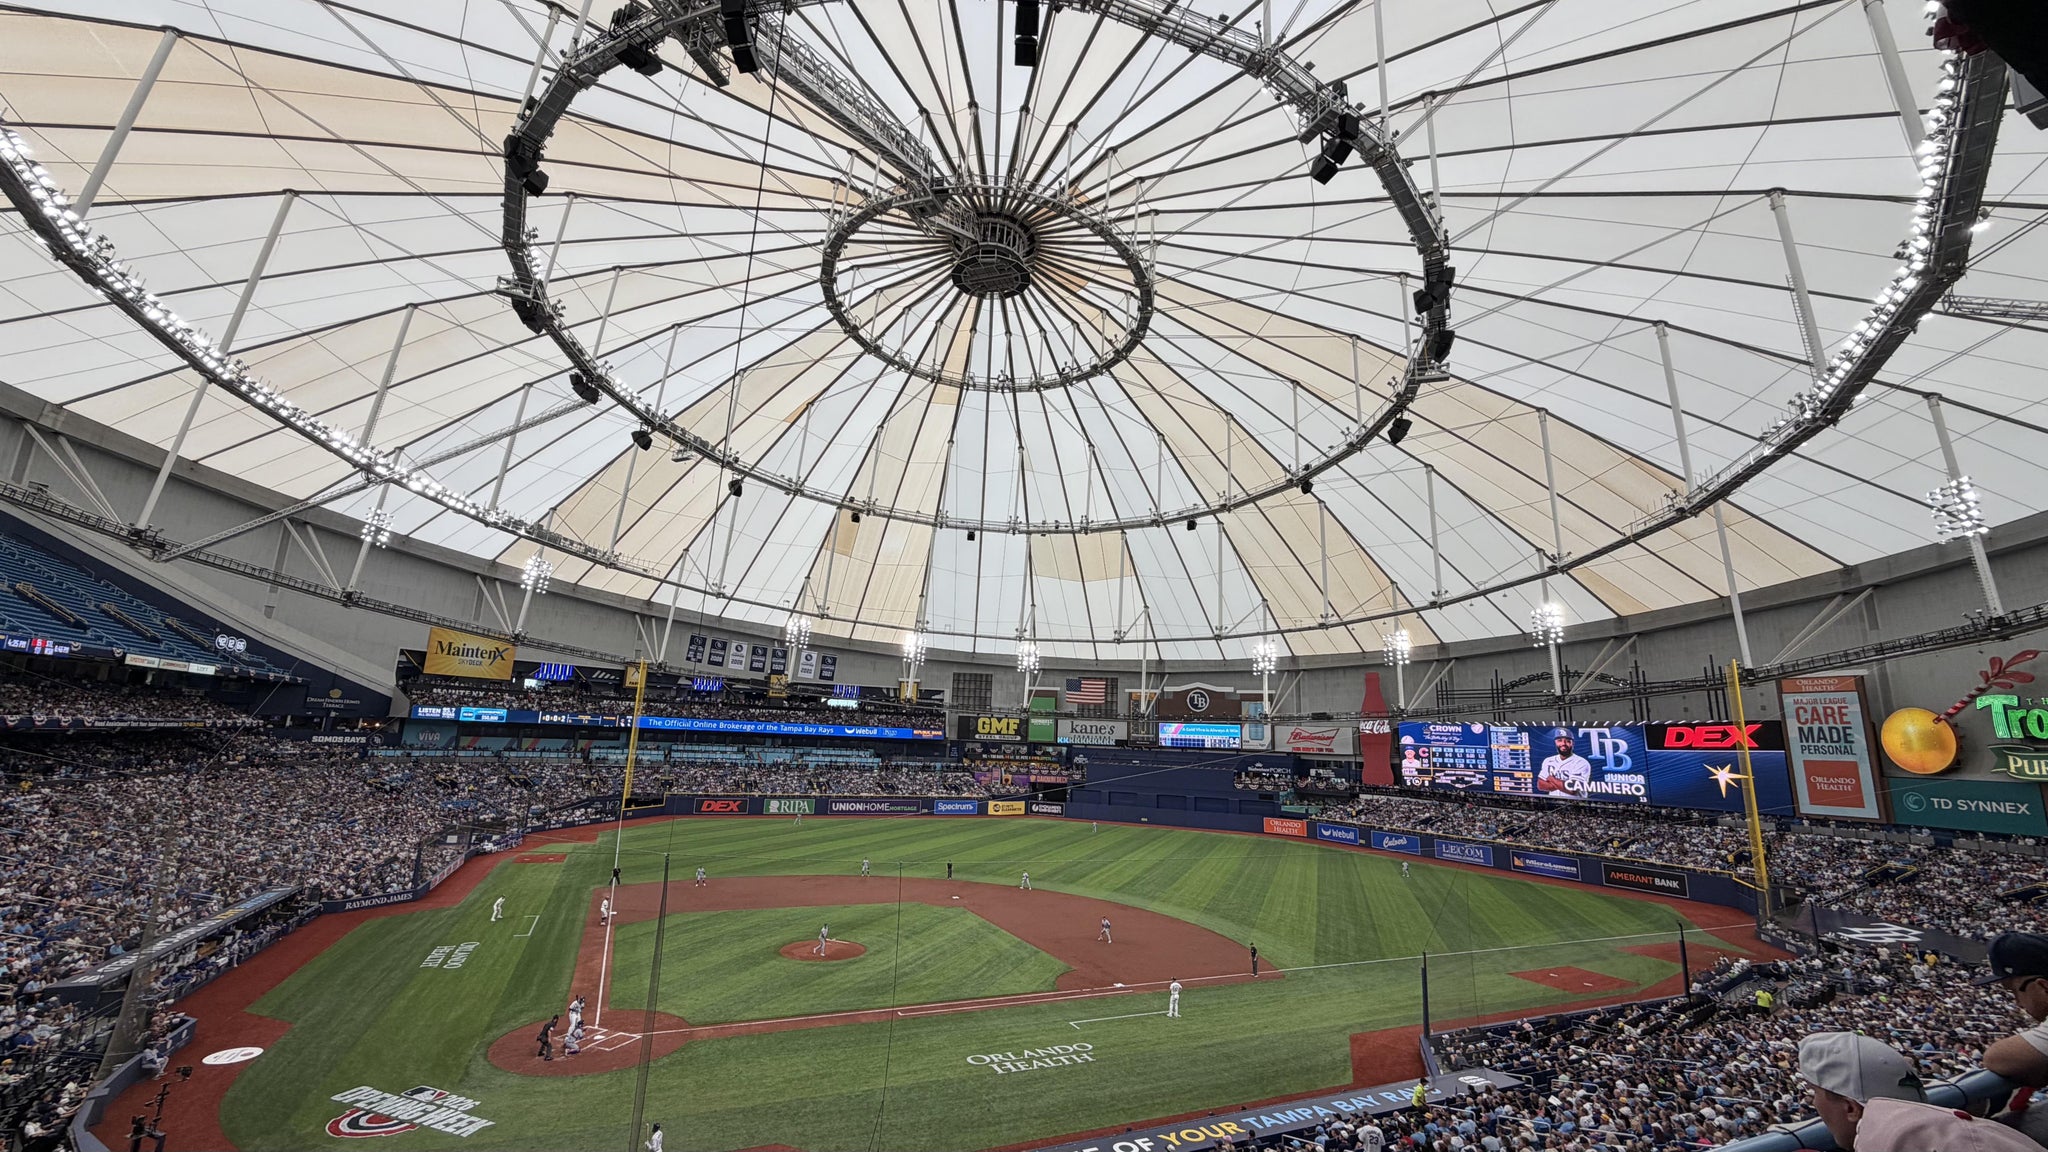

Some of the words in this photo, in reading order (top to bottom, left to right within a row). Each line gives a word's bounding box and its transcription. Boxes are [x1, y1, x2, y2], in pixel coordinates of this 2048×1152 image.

[434, 641, 510, 666] MaintenX
[1191, 694, 1206, 708] TB
[1795, 706, 1852, 725] CARE
[664, 720, 691, 728] Official
[720, 722, 755, 731] Brokerage
[780, 724, 802, 734] Tampa
[804, 726, 817, 734] Bay
[818, 726, 834, 735] Rays
[978, 717, 1020, 734] GMF
[1430, 724, 1462, 732] CROWN
[1290, 732, 1334, 741] Budweiser
[1664, 724, 1763, 748] DEX
[1798, 726, 1855, 744] MADE
[1578, 728, 1632, 771] TB
[1800, 744, 1856, 756] PERSONAL
[1604, 773, 1645, 782] JUNIOR
[1810, 776, 1856, 784] ORLANDO
[1564, 780, 1646, 796] CAMINERO
[1816, 783, 1853, 792] HEALTH
[701, 800, 742, 812] DEX
[780, 800, 810, 813] RIPA
[938, 802, 970, 811] Spectrum
[1930, 798, 1952, 810] TD
[1957, 799, 2031, 815] SYNNEX
[1270, 820, 1301, 828] ORLANDO
[1332, 828, 1354, 840] Webull
[1442, 844, 1484, 858] LECOM
[1610, 871, 1654, 885] AMERANT
[1654, 878, 1680, 889] BANK
[344, 896, 386, 910] RAYMOND
[386, 892, 413, 904] JAMES
[966, 1042, 1093, 1066] ORLANDO
[990, 1053, 1096, 1074] HEALTH
[330, 1086, 438, 1120] OPENING
[412, 1107, 496, 1138] WEEK
[1157, 1121, 1246, 1146] YOUR
[1241, 1105, 1336, 1130] TAMPA
[1331, 1094, 1381, 1114] BAY
[1369, 1135, 1379, 1144] 23
